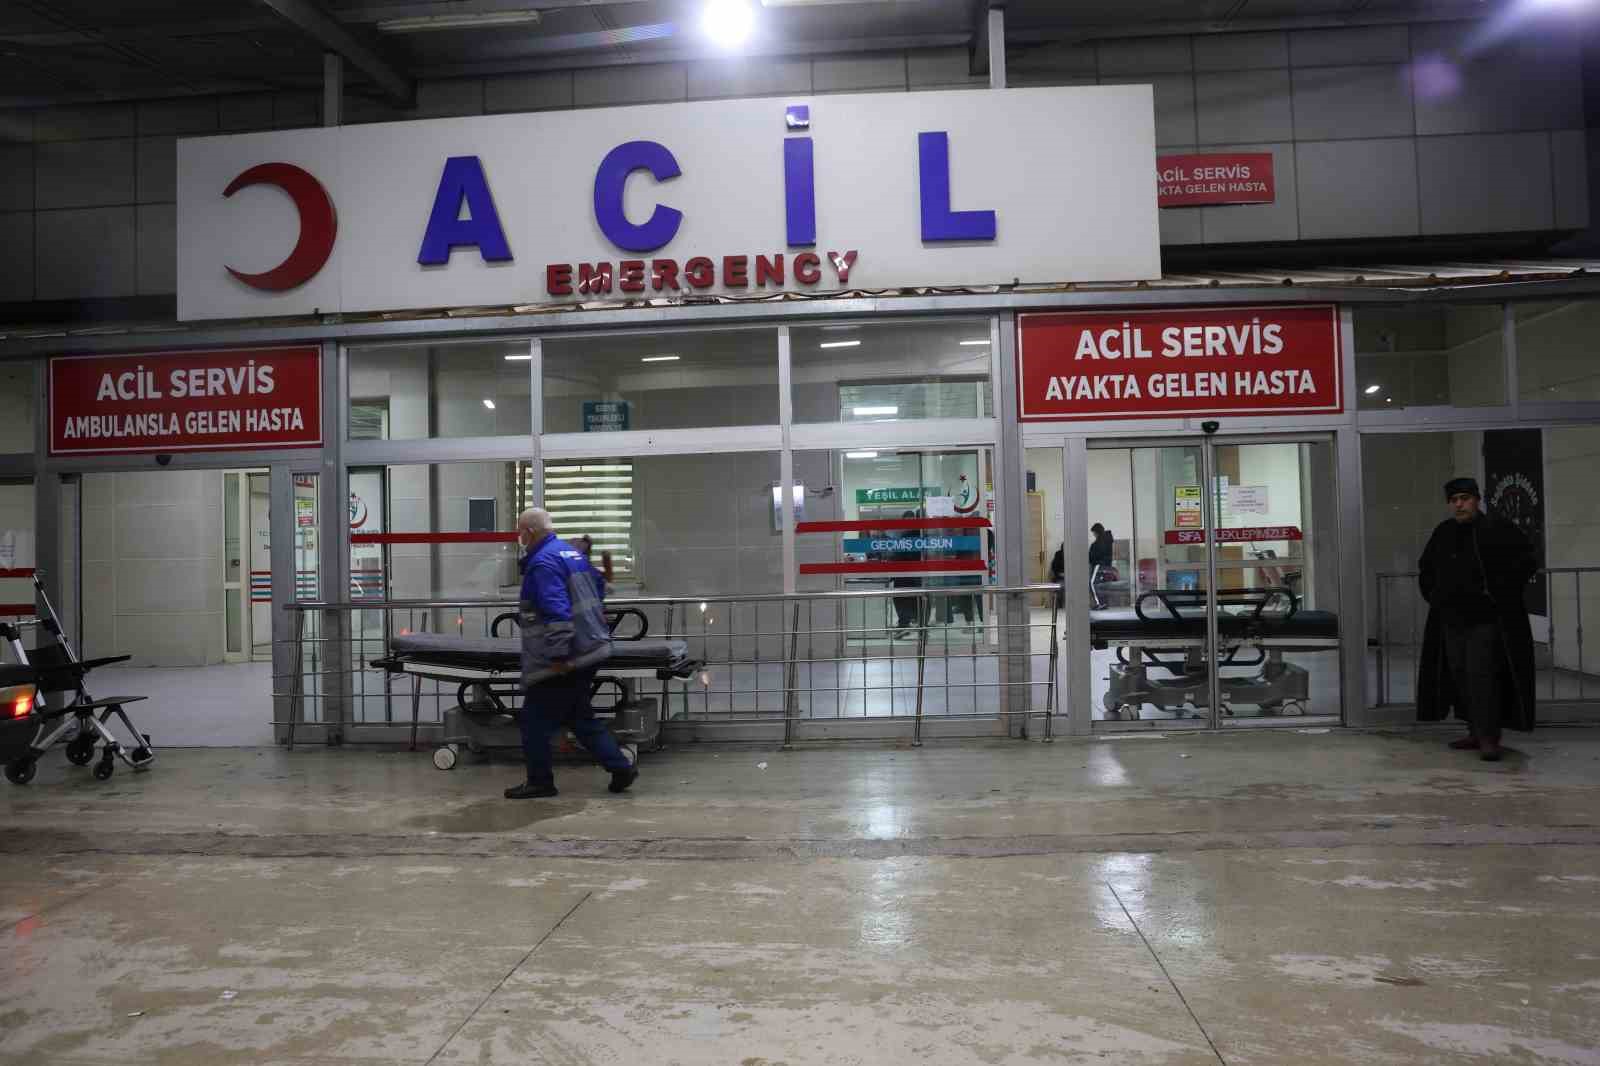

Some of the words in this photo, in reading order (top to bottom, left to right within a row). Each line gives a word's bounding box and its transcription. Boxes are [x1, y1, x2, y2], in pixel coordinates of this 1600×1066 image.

[417, 105, 997, 267] ACİL
[1159, 184, 1183, 196] KTA
[1185, 183, 1226, 194] GELEN
[1229, 181, 1268, 193] HASTA
[1193, 163, 1251, 180] SERVİS
[546, 250, 859, 295] EMERGENCY
[1075, 320, 1153, 360] ACİL
[1161, 317, 1284, 358] SERVİS
[96, 364, 162, 401] ACİL
[169, 359, 275, 398] SERVİS
[1045, 373, 1142, 401] AYAKTA
[1148, 371, 1228, 398] GELEN
[1235, 369, 1317, 395] HASTA
[63, 412, 181, 439] AMBULANSLA
[185, 409, 242, 435] GELEN
[246, 407, 305, 432] HASTA
